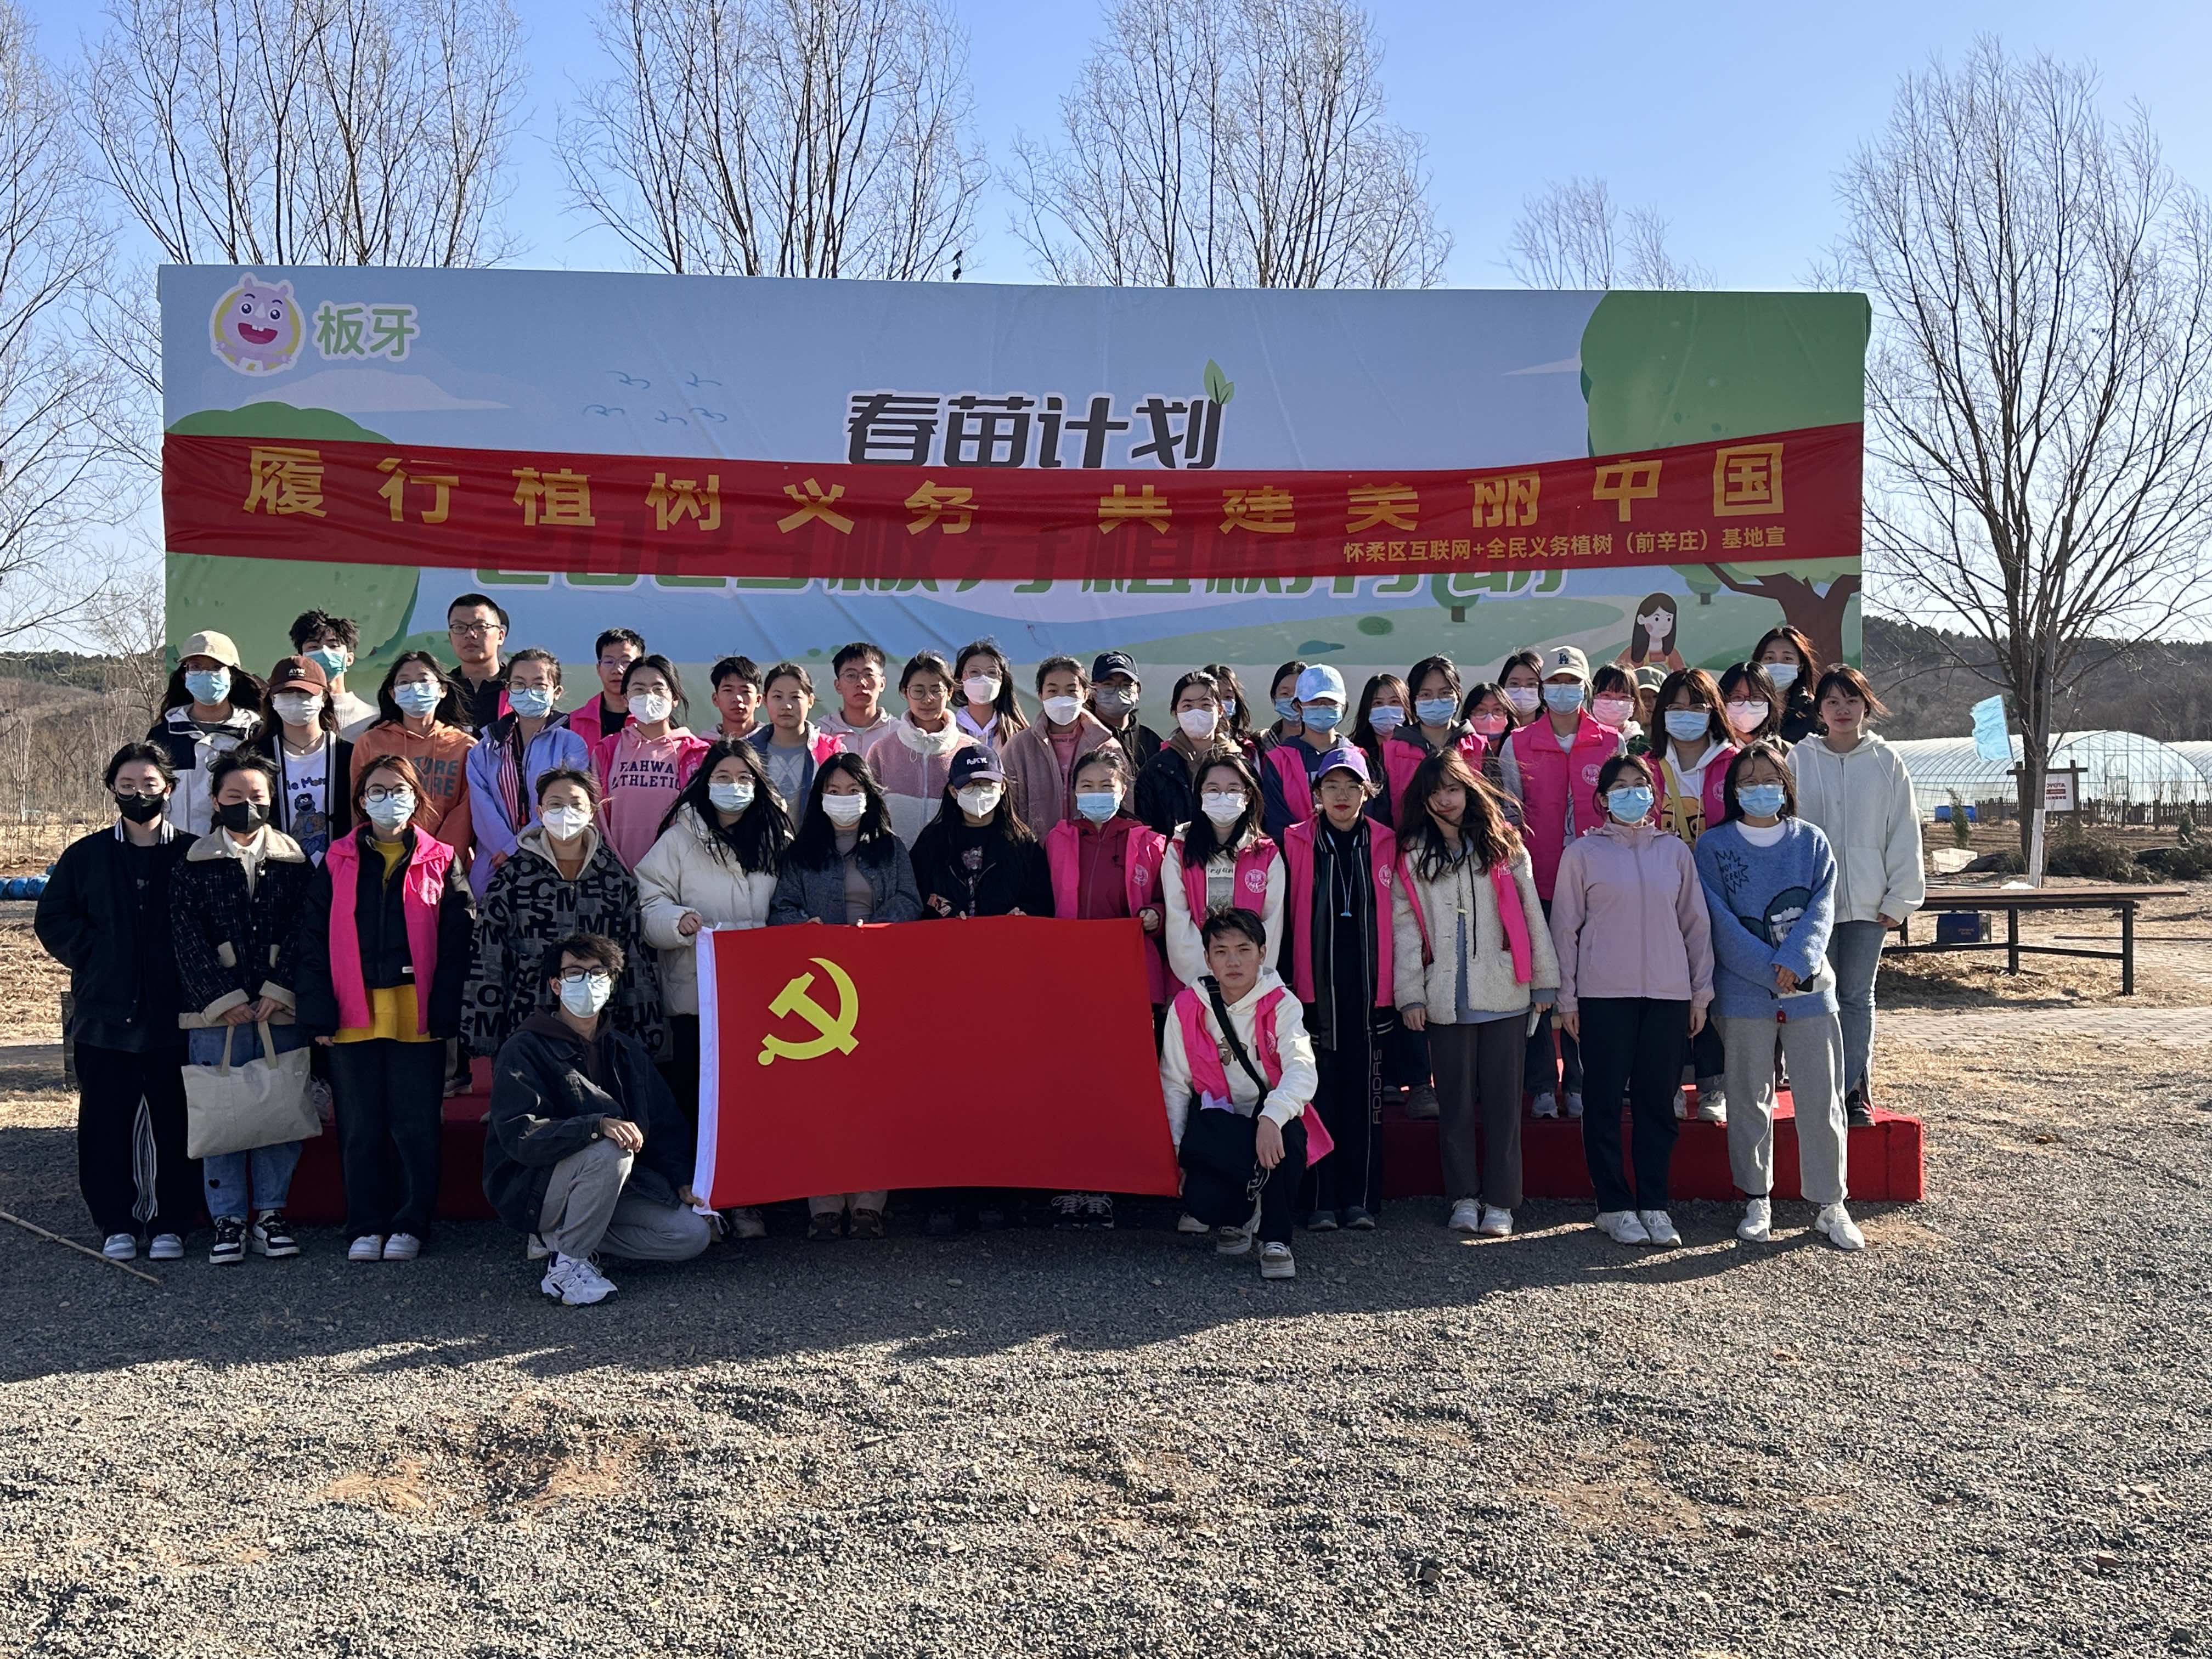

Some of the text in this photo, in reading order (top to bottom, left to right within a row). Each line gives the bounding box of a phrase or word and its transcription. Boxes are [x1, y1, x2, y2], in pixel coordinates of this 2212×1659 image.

[317, 305, 416, 357] 板牙
[847, 393, 1223, 469] 春苗计划
[242, 443, 1785, 535] 履行植树义务 共建美丽中国
[620, 760, 675, 774] RAHWA
[1373, 1048, 1383, 1124] ADIDAS
